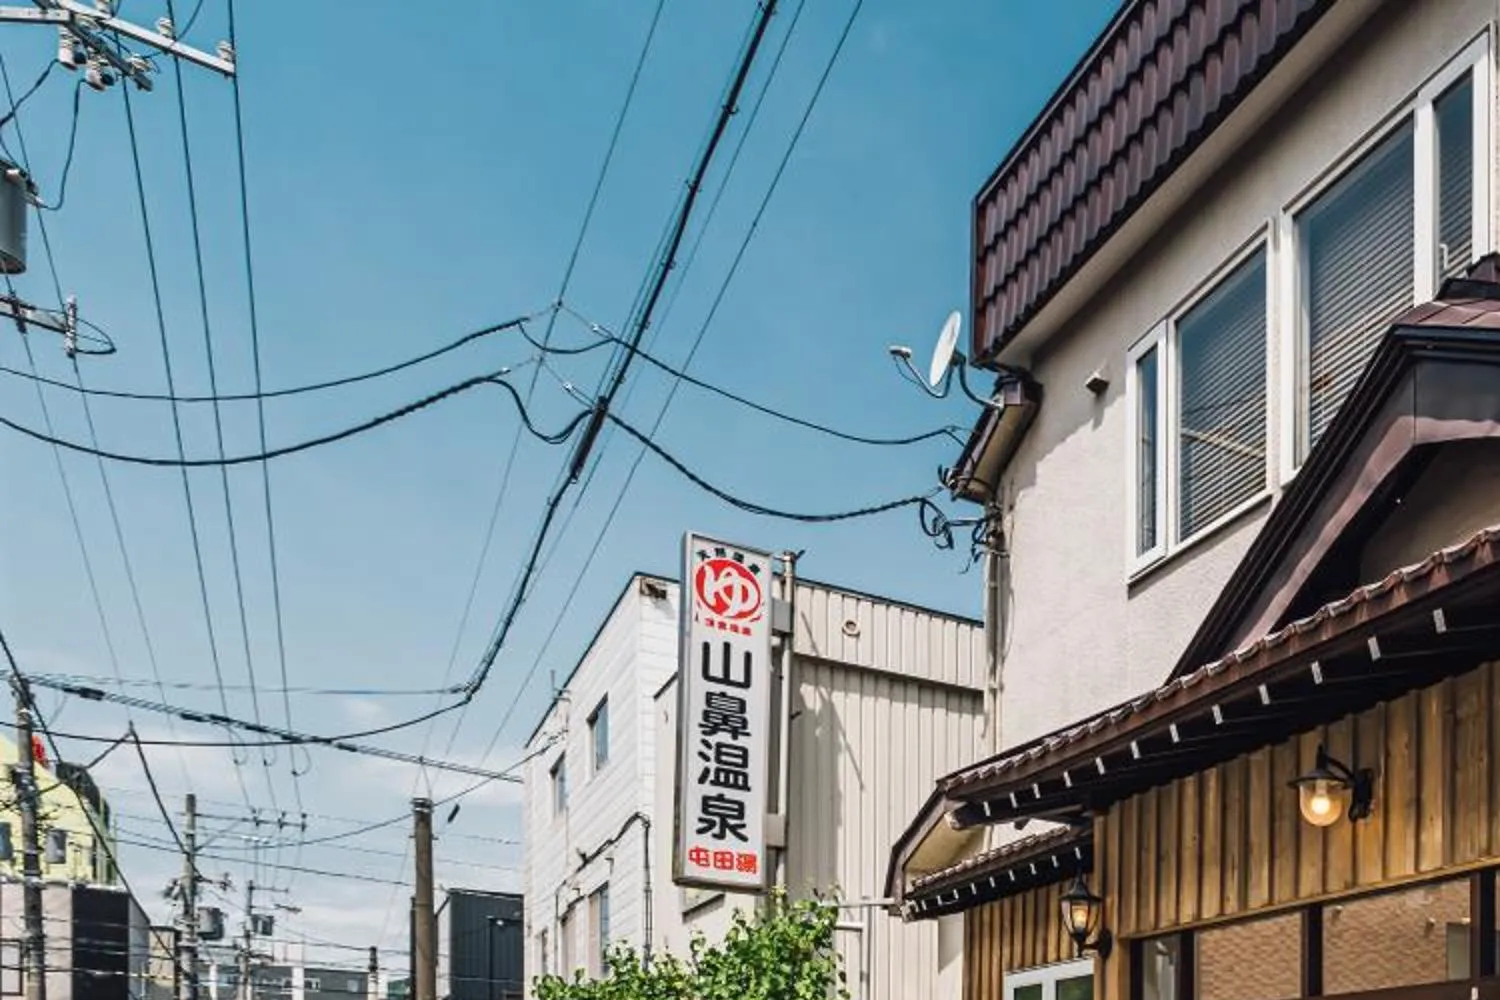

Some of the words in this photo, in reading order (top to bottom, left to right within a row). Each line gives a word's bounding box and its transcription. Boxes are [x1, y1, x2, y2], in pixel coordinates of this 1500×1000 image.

[703, 563, 758, 618] ゆ
[696, 641, 752, 842] 山鼻温泉
